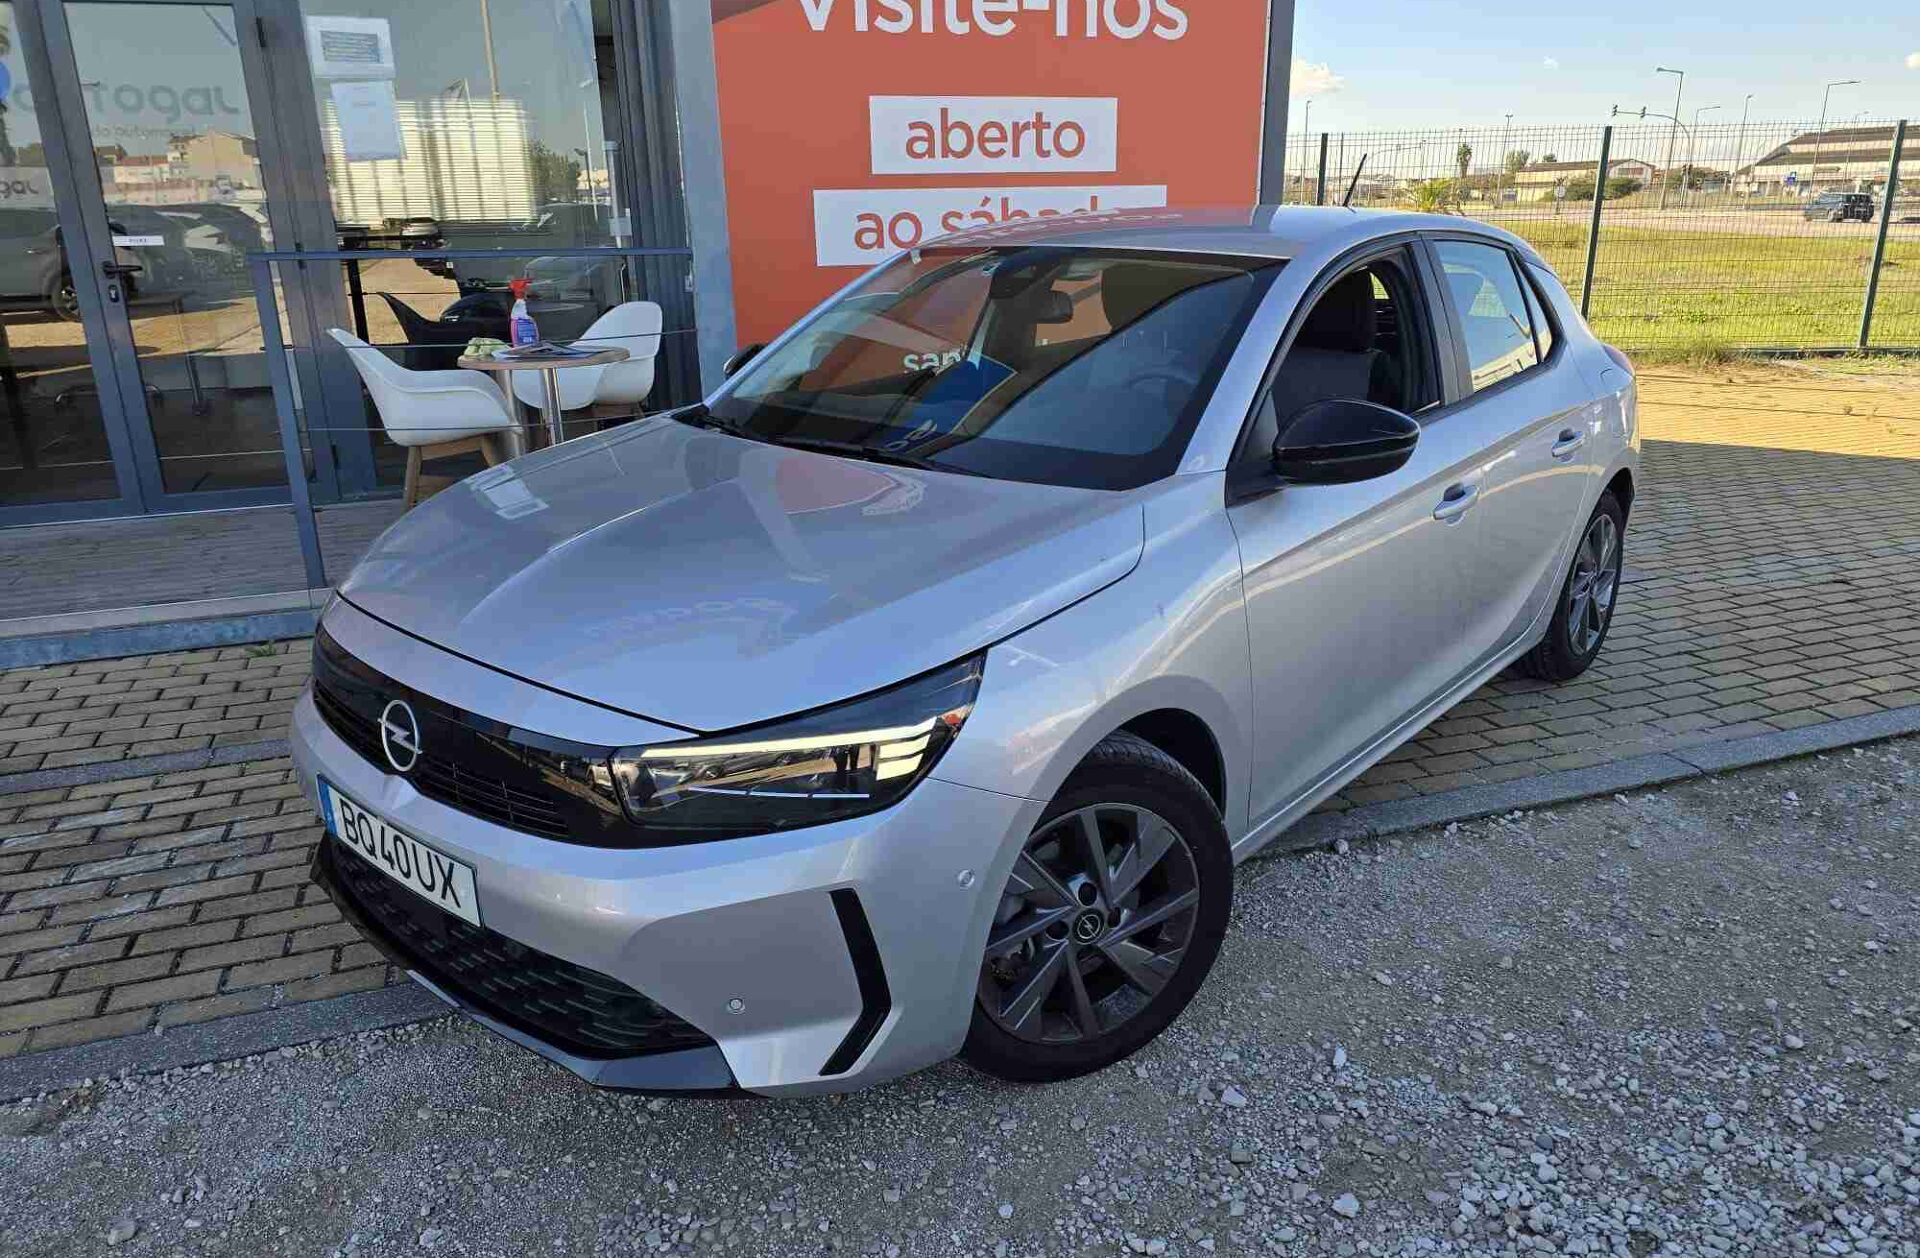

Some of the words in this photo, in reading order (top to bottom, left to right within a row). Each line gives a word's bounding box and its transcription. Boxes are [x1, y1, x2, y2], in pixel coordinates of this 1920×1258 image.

[904, 107, 1086, 159] aberto
[854, 211, 922, 249] ao
[339, 797, 462, 909] BQ40UX
